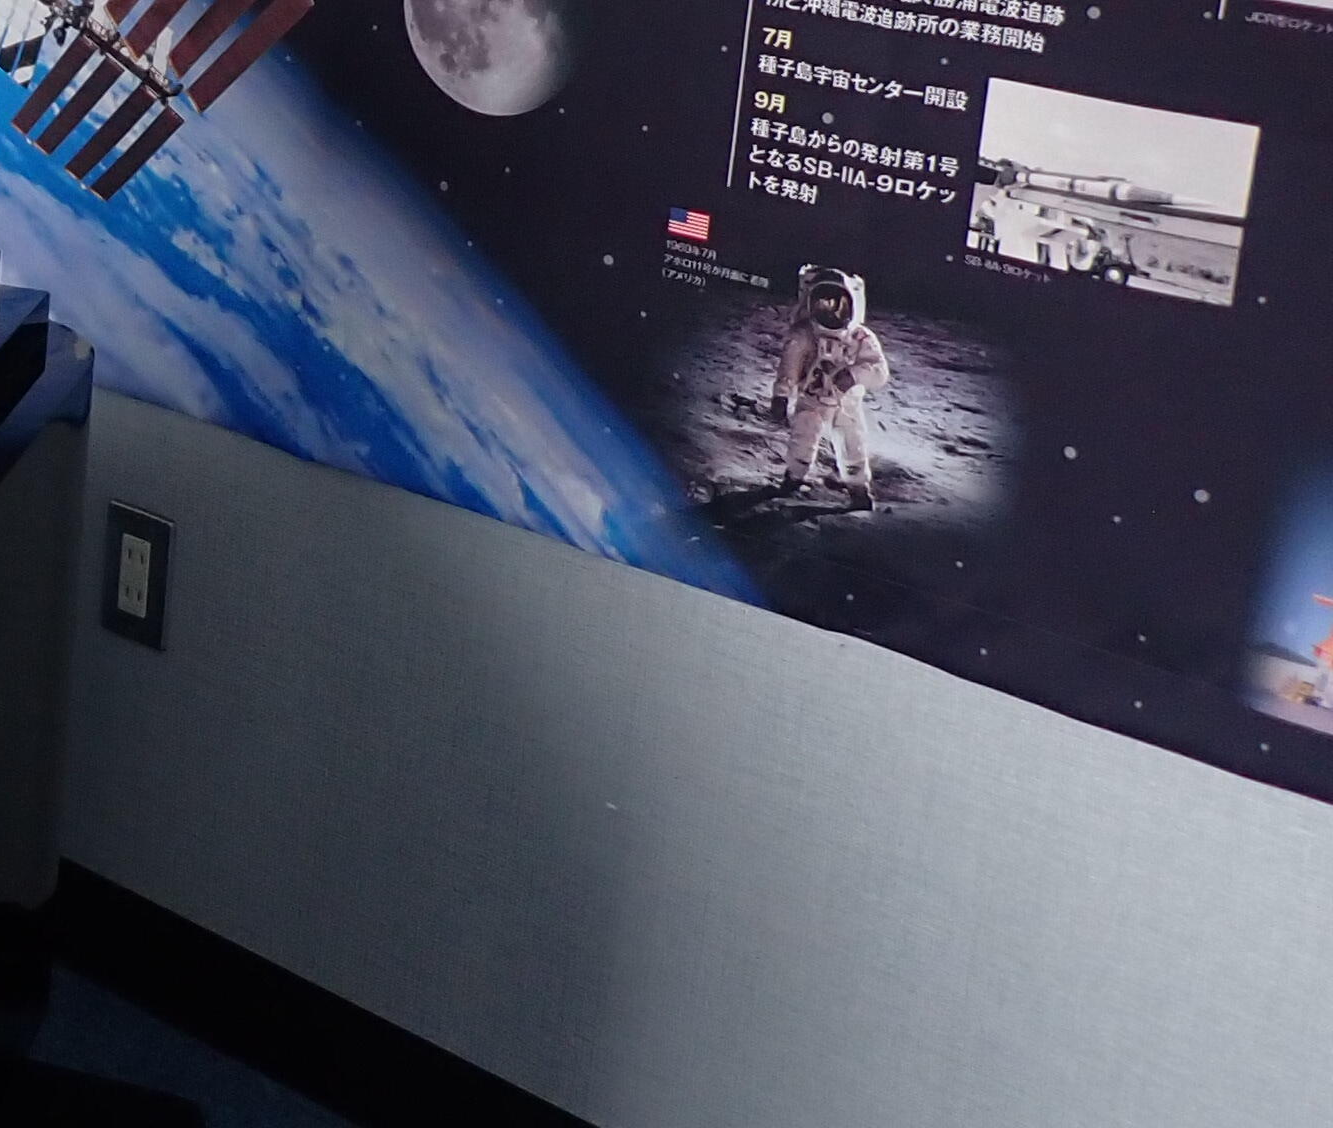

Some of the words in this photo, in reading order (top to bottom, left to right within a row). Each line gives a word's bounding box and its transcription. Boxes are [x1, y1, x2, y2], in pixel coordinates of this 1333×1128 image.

[761, 27, 793, 51] 7月
[757, 53, 970, 112] 種子島宇宙センター開設
[753, 90, 787, 115] 9月
[750, 117, 961, 179] 種子島からの発射第1号
[748, 170, 820, 207] トを発射
[661, 267, 707, 288] (アメリカ)
